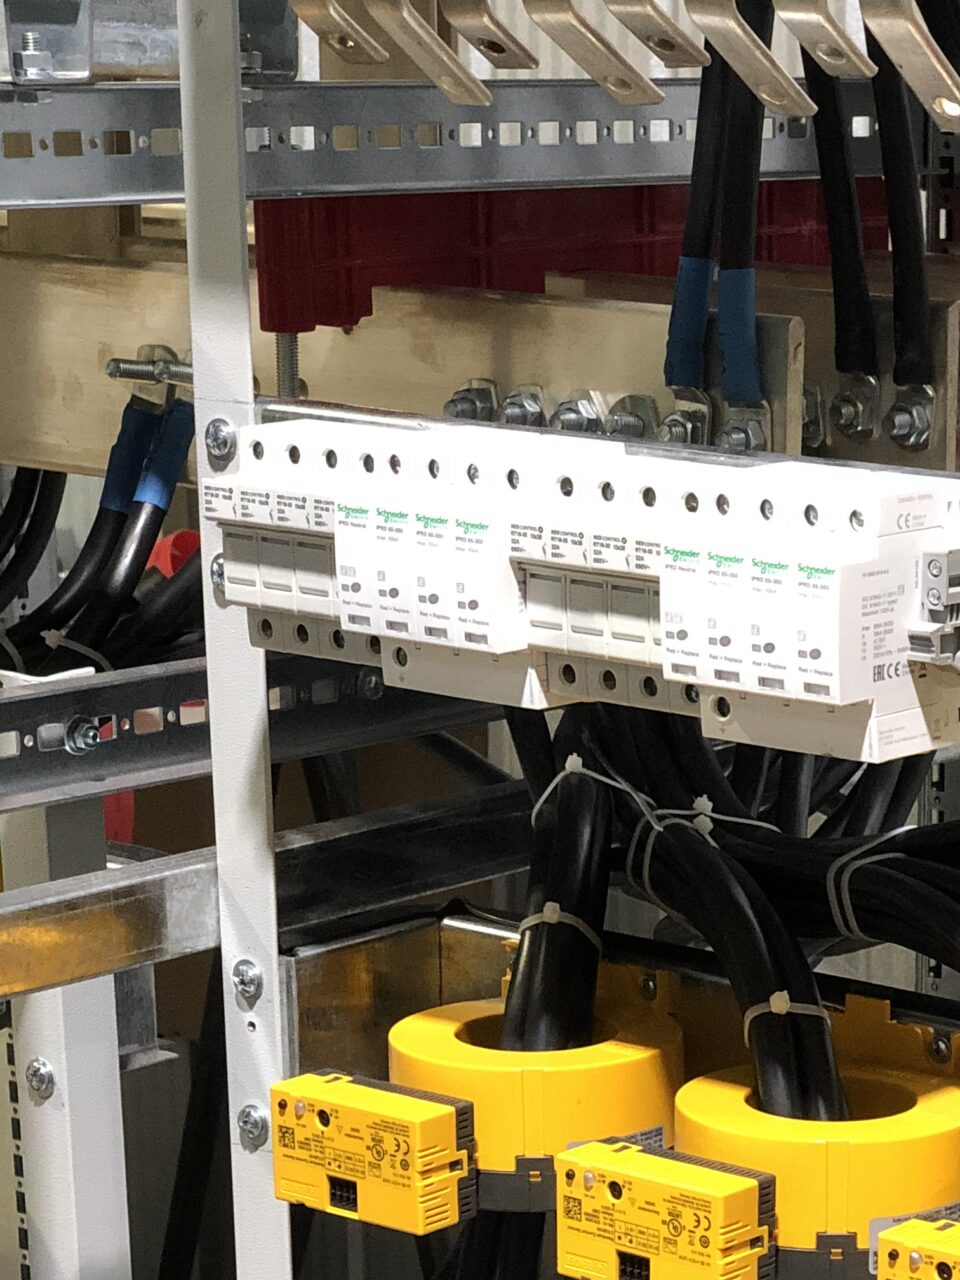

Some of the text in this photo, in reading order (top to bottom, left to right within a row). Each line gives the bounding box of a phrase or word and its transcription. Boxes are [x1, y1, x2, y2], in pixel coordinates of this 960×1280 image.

[337, 503, 369, 515] Schneider
[376, 507, 409, 519] Schneider
[415, 513, 448, 525] Schneider
[455, 519, 489, 531] Schneider
[664, 545, 700, 558] Schneider
[707, 551, 744, 564] Schneider
[751, 558, 789, 571] Schneider
[797, 563, 836, 576] Schneider
